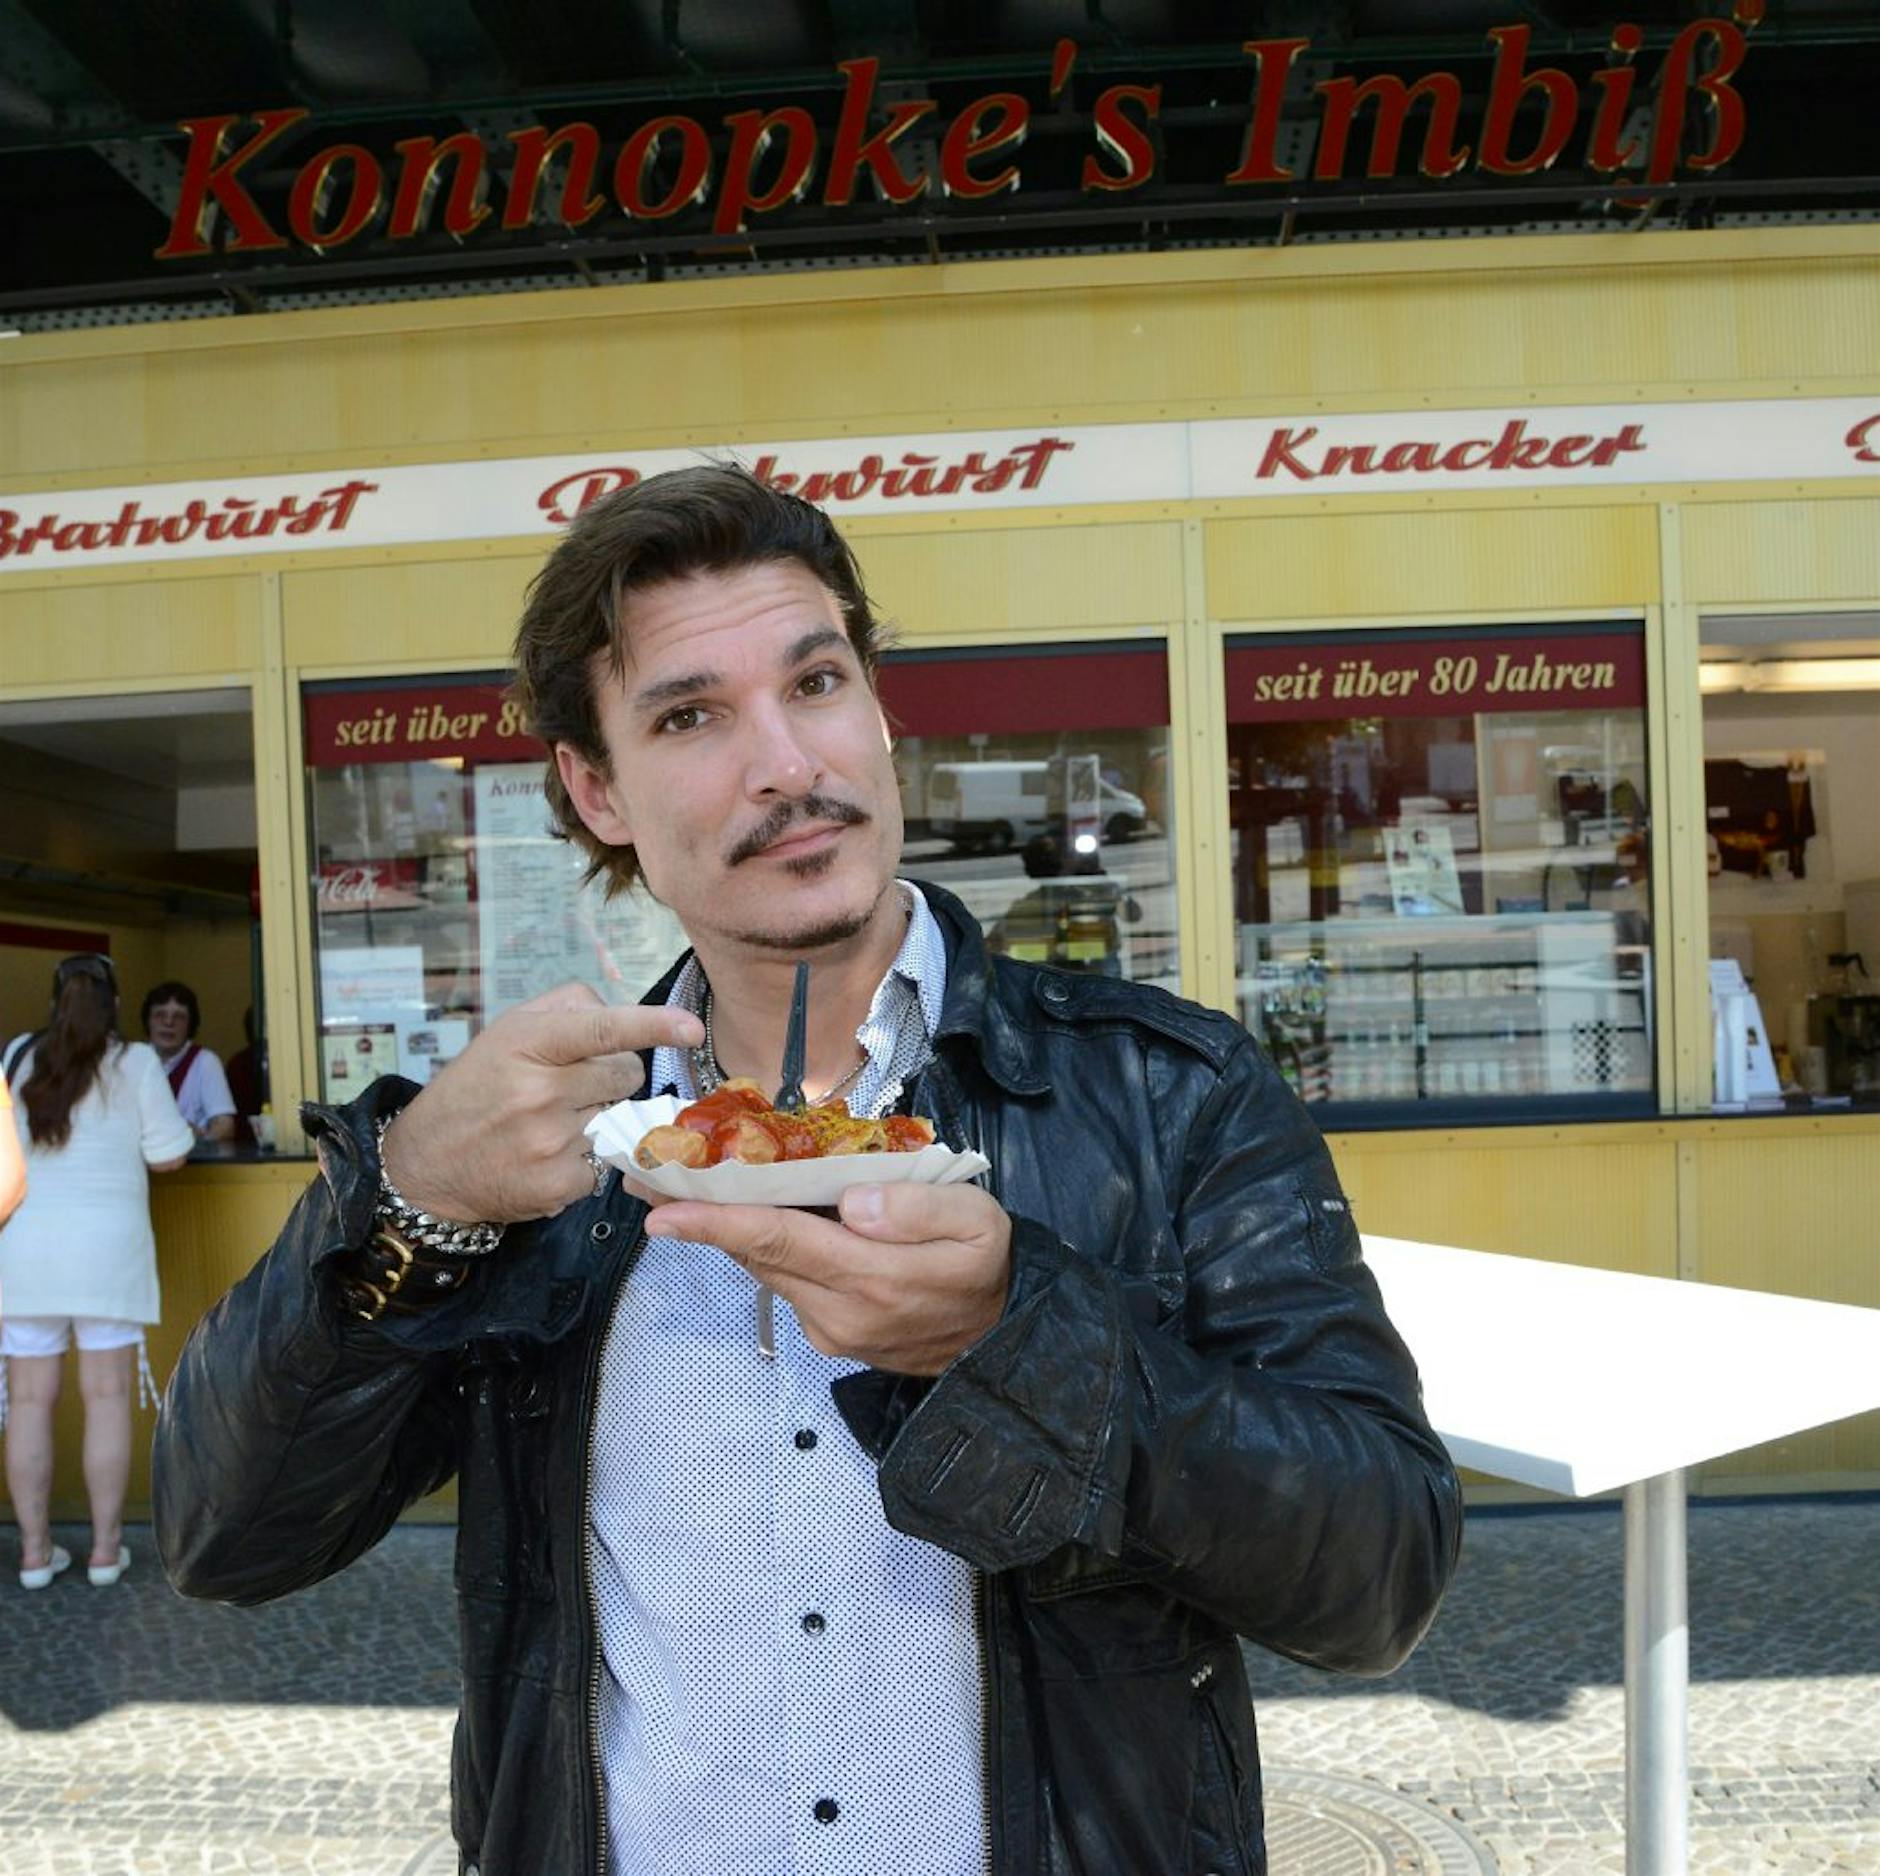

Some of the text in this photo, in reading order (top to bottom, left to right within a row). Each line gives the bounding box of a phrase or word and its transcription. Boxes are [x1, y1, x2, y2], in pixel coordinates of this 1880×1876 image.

[154, 0, 1766, 259] Konnopke's Imbiß
[1256, 419, 1647, 480] Knacker
[0, 480, 379, 559] ratwurst
[1254, 653, 1615, 700] seit über 80 Jahren
[335, 708, 397, 746] seit
[407, 705, 488, 741] über
[489, 778, 546, 797] Konn
